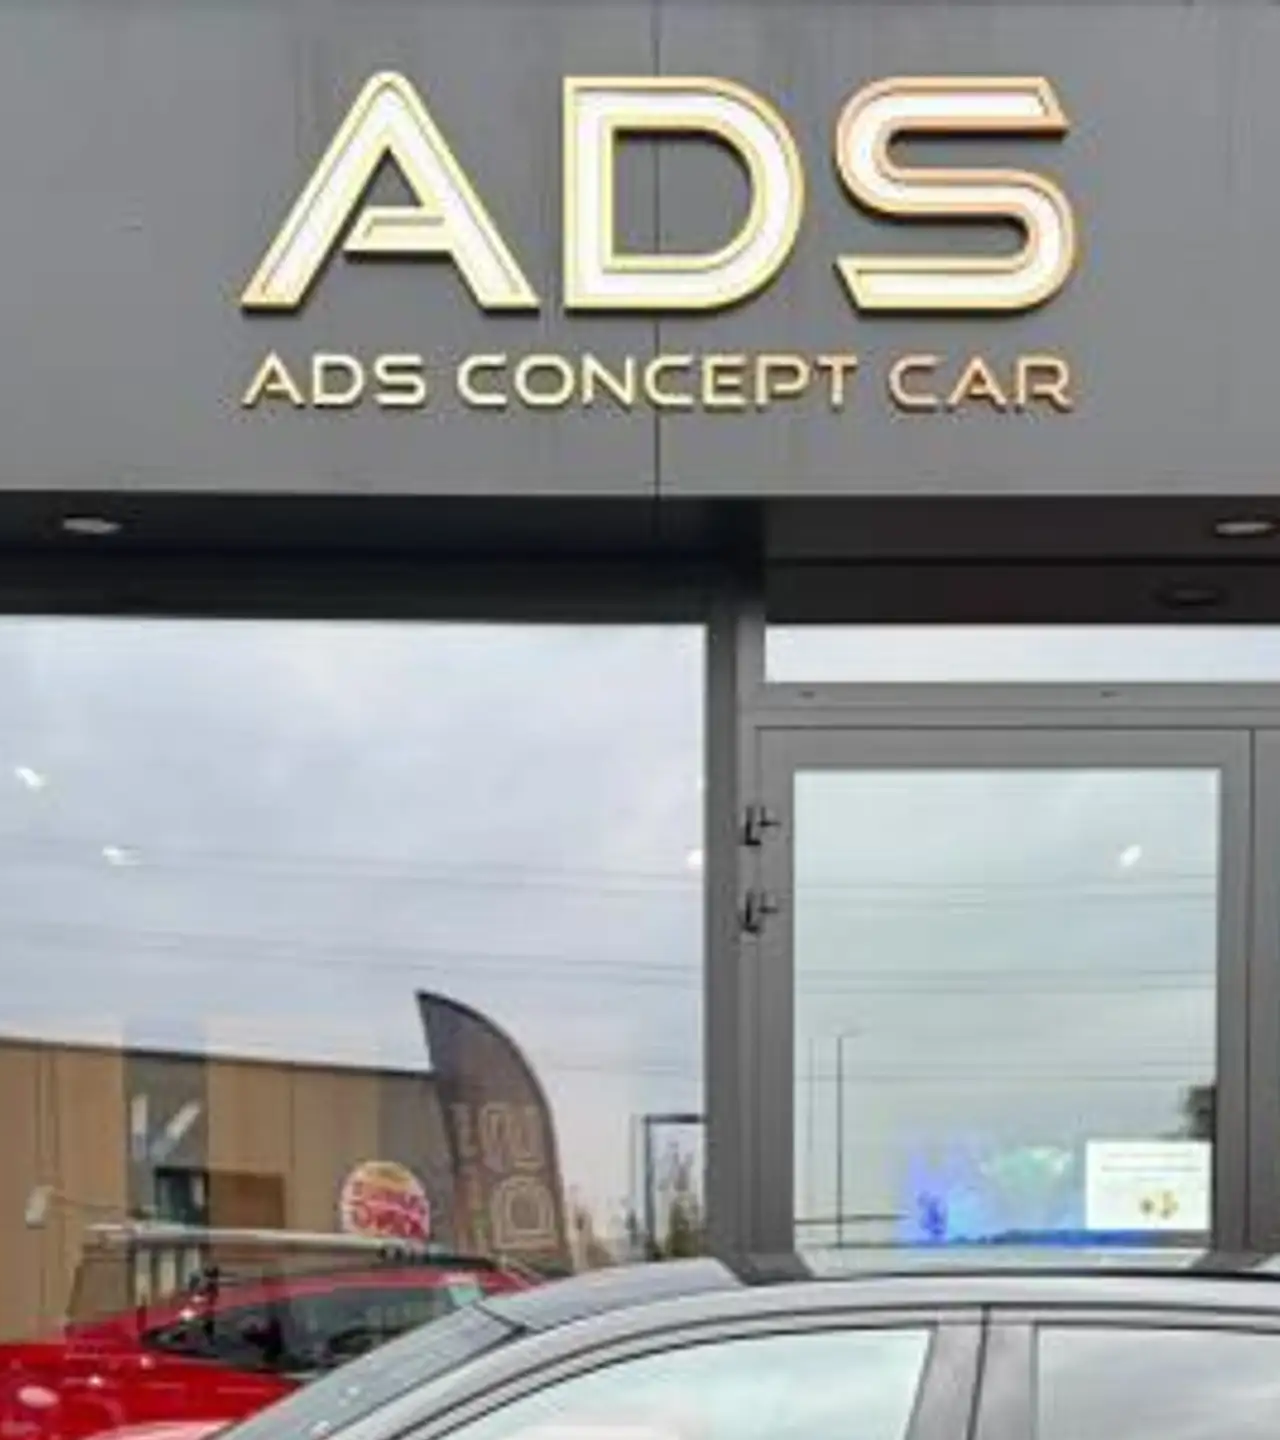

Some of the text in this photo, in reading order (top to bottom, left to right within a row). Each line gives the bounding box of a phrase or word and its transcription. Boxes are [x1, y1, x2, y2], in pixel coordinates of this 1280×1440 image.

[241, 70, 1077, 311] ADS
[242, 352, 1076, 412] ADS CONCEPT CAR
